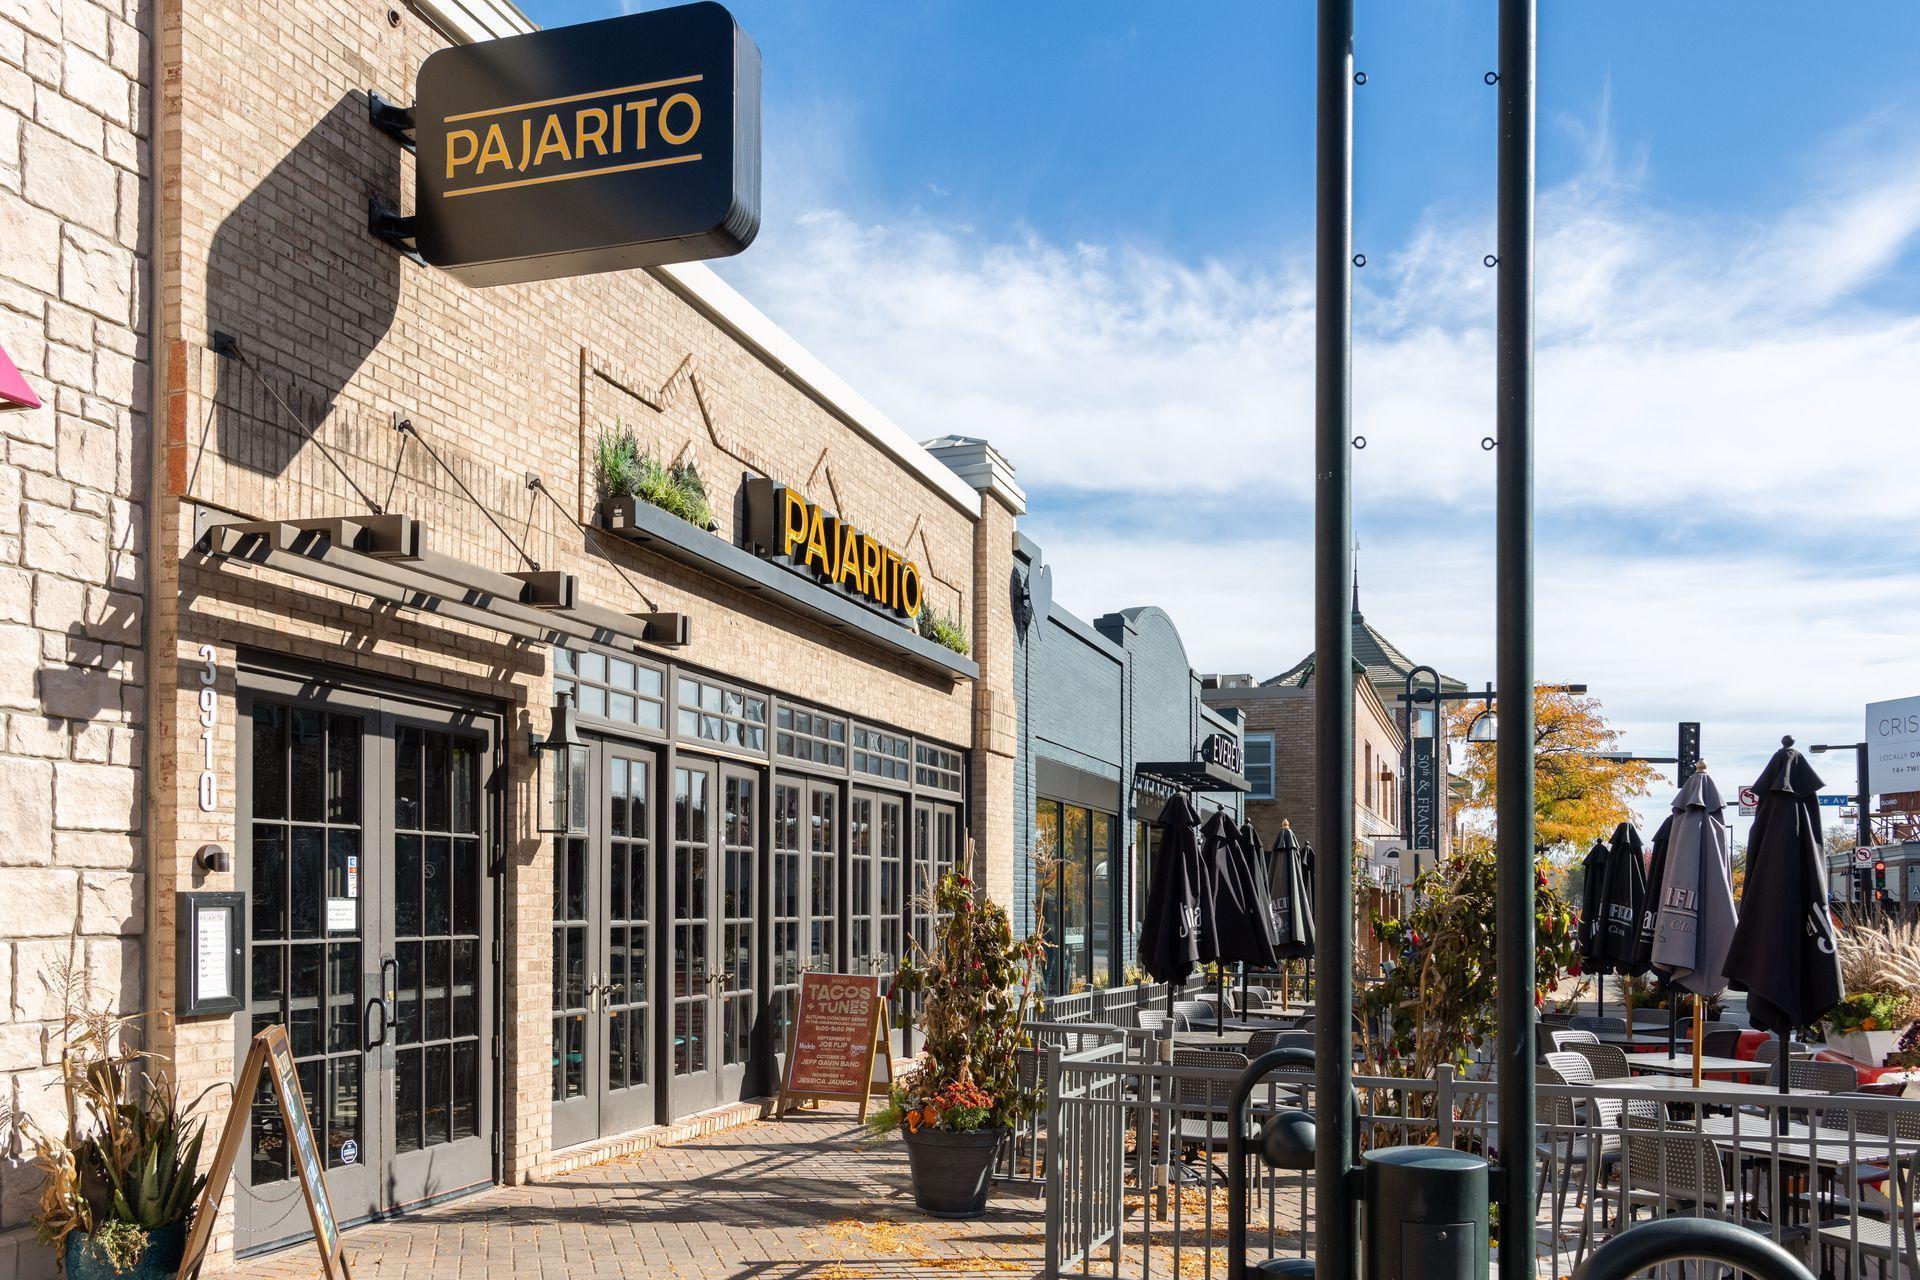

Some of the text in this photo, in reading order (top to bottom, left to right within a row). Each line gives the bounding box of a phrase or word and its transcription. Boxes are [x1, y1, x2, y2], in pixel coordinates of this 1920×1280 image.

[446, 93, 701, 179] PAJARITO
[785, 487, 922, 618] PAJARITO
[199, 644, 217, 812] 3910
[1417, 797, 1430, 849] FRANC
[808, 984, 871, 1000] TACOS
[818, 1000, 869, 1015] TUNES
[797, 1077, 826, 1085] JESSICA
